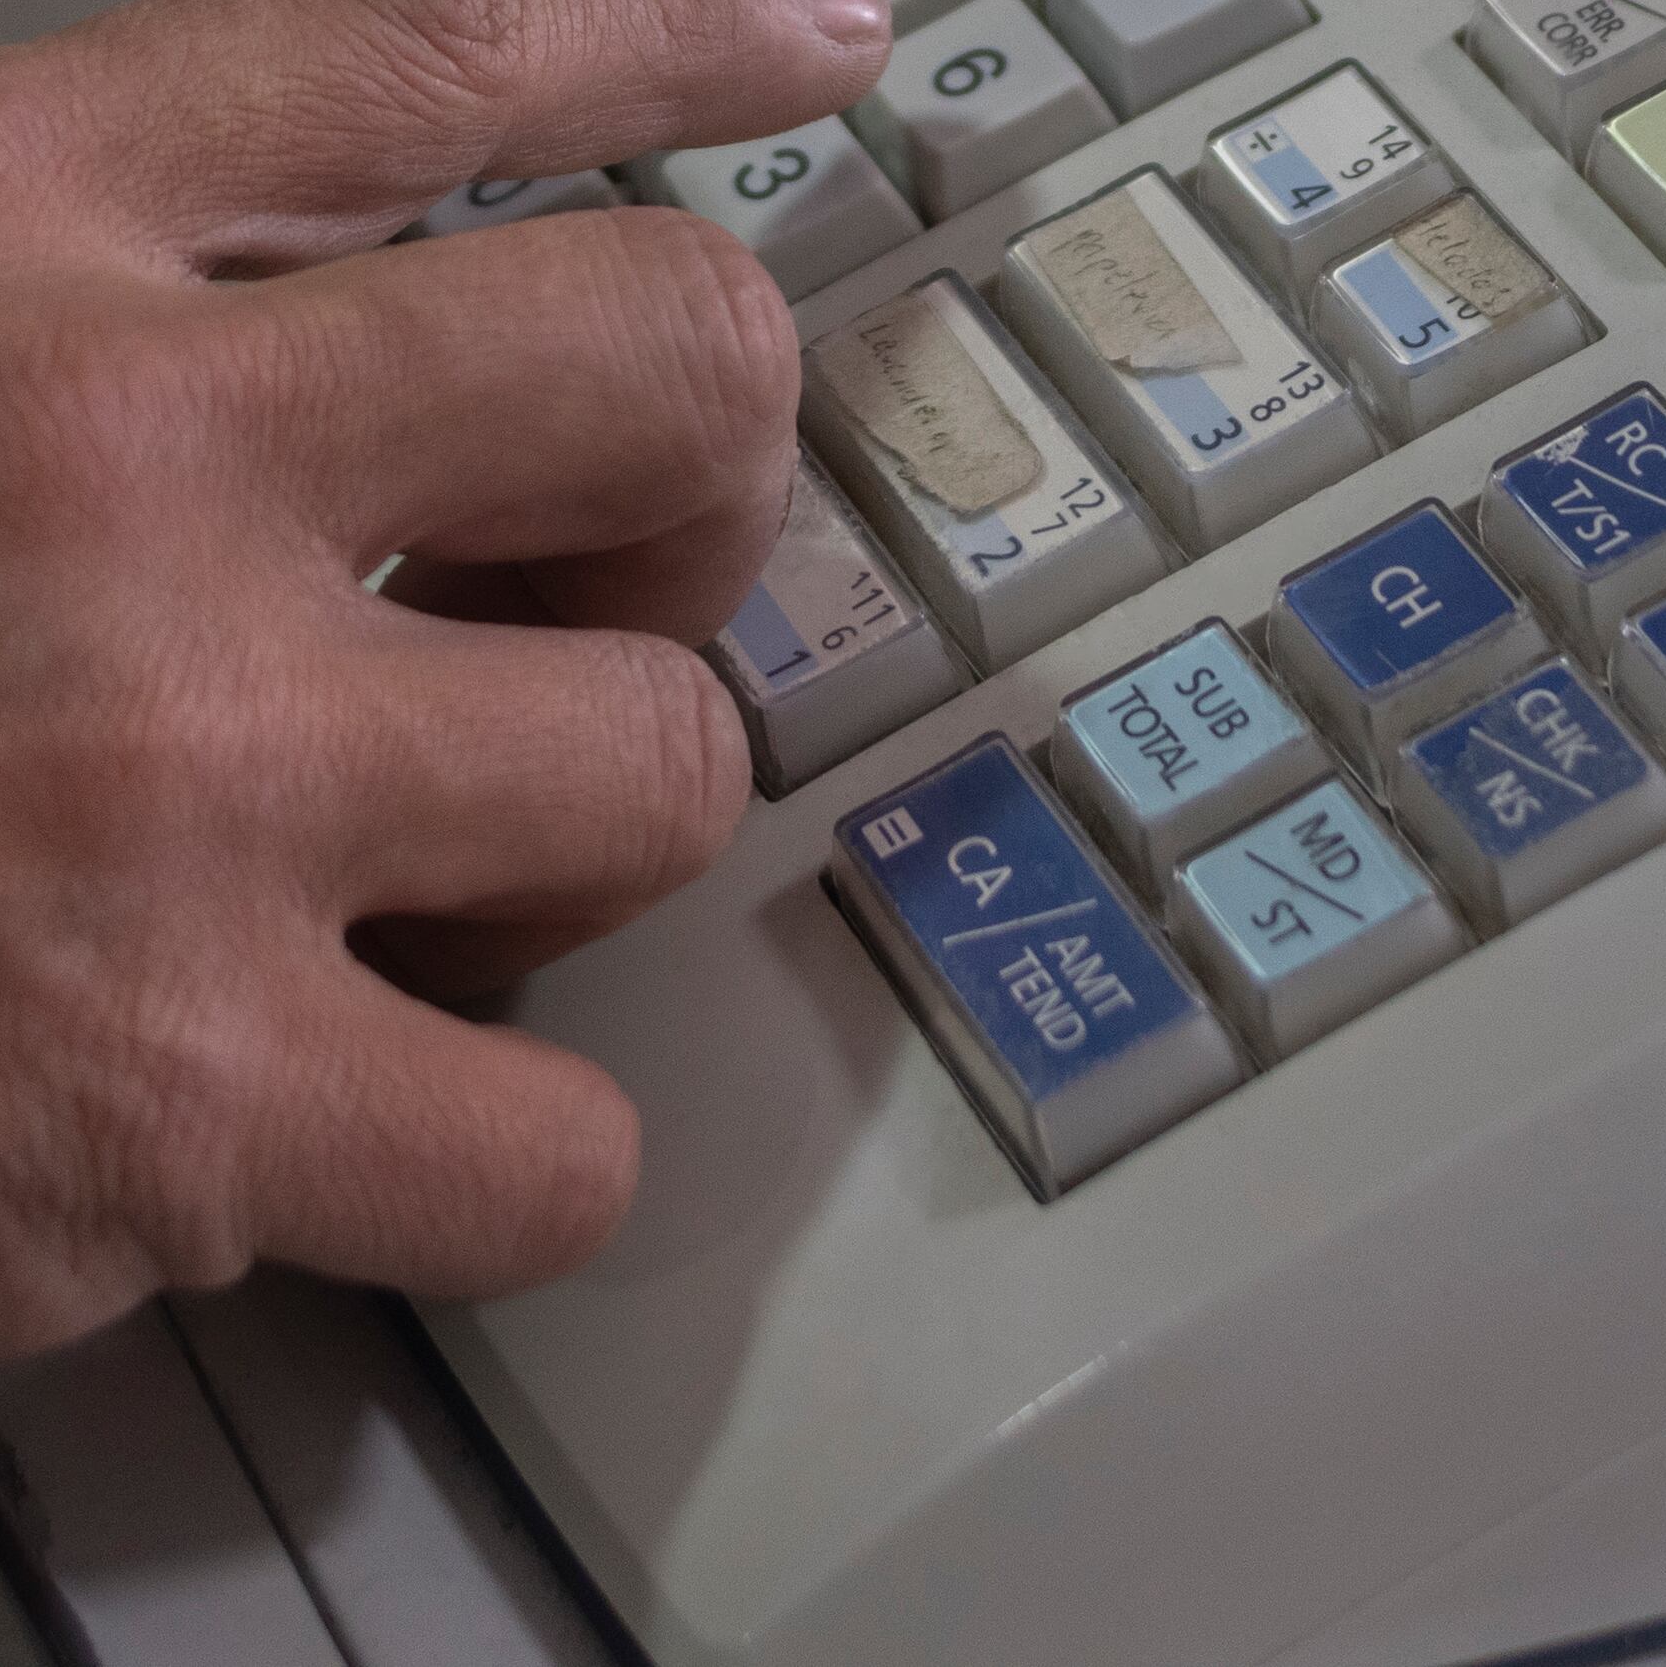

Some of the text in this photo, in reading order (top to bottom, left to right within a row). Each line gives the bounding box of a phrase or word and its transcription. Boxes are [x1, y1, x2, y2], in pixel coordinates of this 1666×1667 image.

[1536, 11, 1598, 67] CORR
[933, 48, 1007, 97] 6
[1367, 123, 1413, 163] 14
[734, 147, 811, 201] 3
[1339, 156, 1375, 182] 9
[1291, 182, 1334, 214] 4
[1398, 317, 1451, 351] 5
[1278, 359, 1326, 401] 13
[1191, 415, 1243, 453] 3
[1249, 396, 1287, 424] 8
[1058, 477, 1105, 521] 12
[1549, 478, 1630, 555] T/S1
[1031, 511, 1069, 538] 7
[970, 535, 1024, 579] 2
[1370, 564, 1443, 629] CH
[821, 624, 858, 651] 6
[765, 650, 813, 680] 1
[1174, 667, 1250, 741] SUB
[1106, 683, 1199, 793] TOTAL
[1515, 688, 1599, 774] CHK
[1475, 769, 1544, 827] NS
[1289, 810, 1361, 882] MD
[946, 835, 1013, 910] CA
[1250, 899, 1314, 948] ST
[998, 945, 1087, 1052] TEND
[1044, 934, 1136, 1019] AMT
